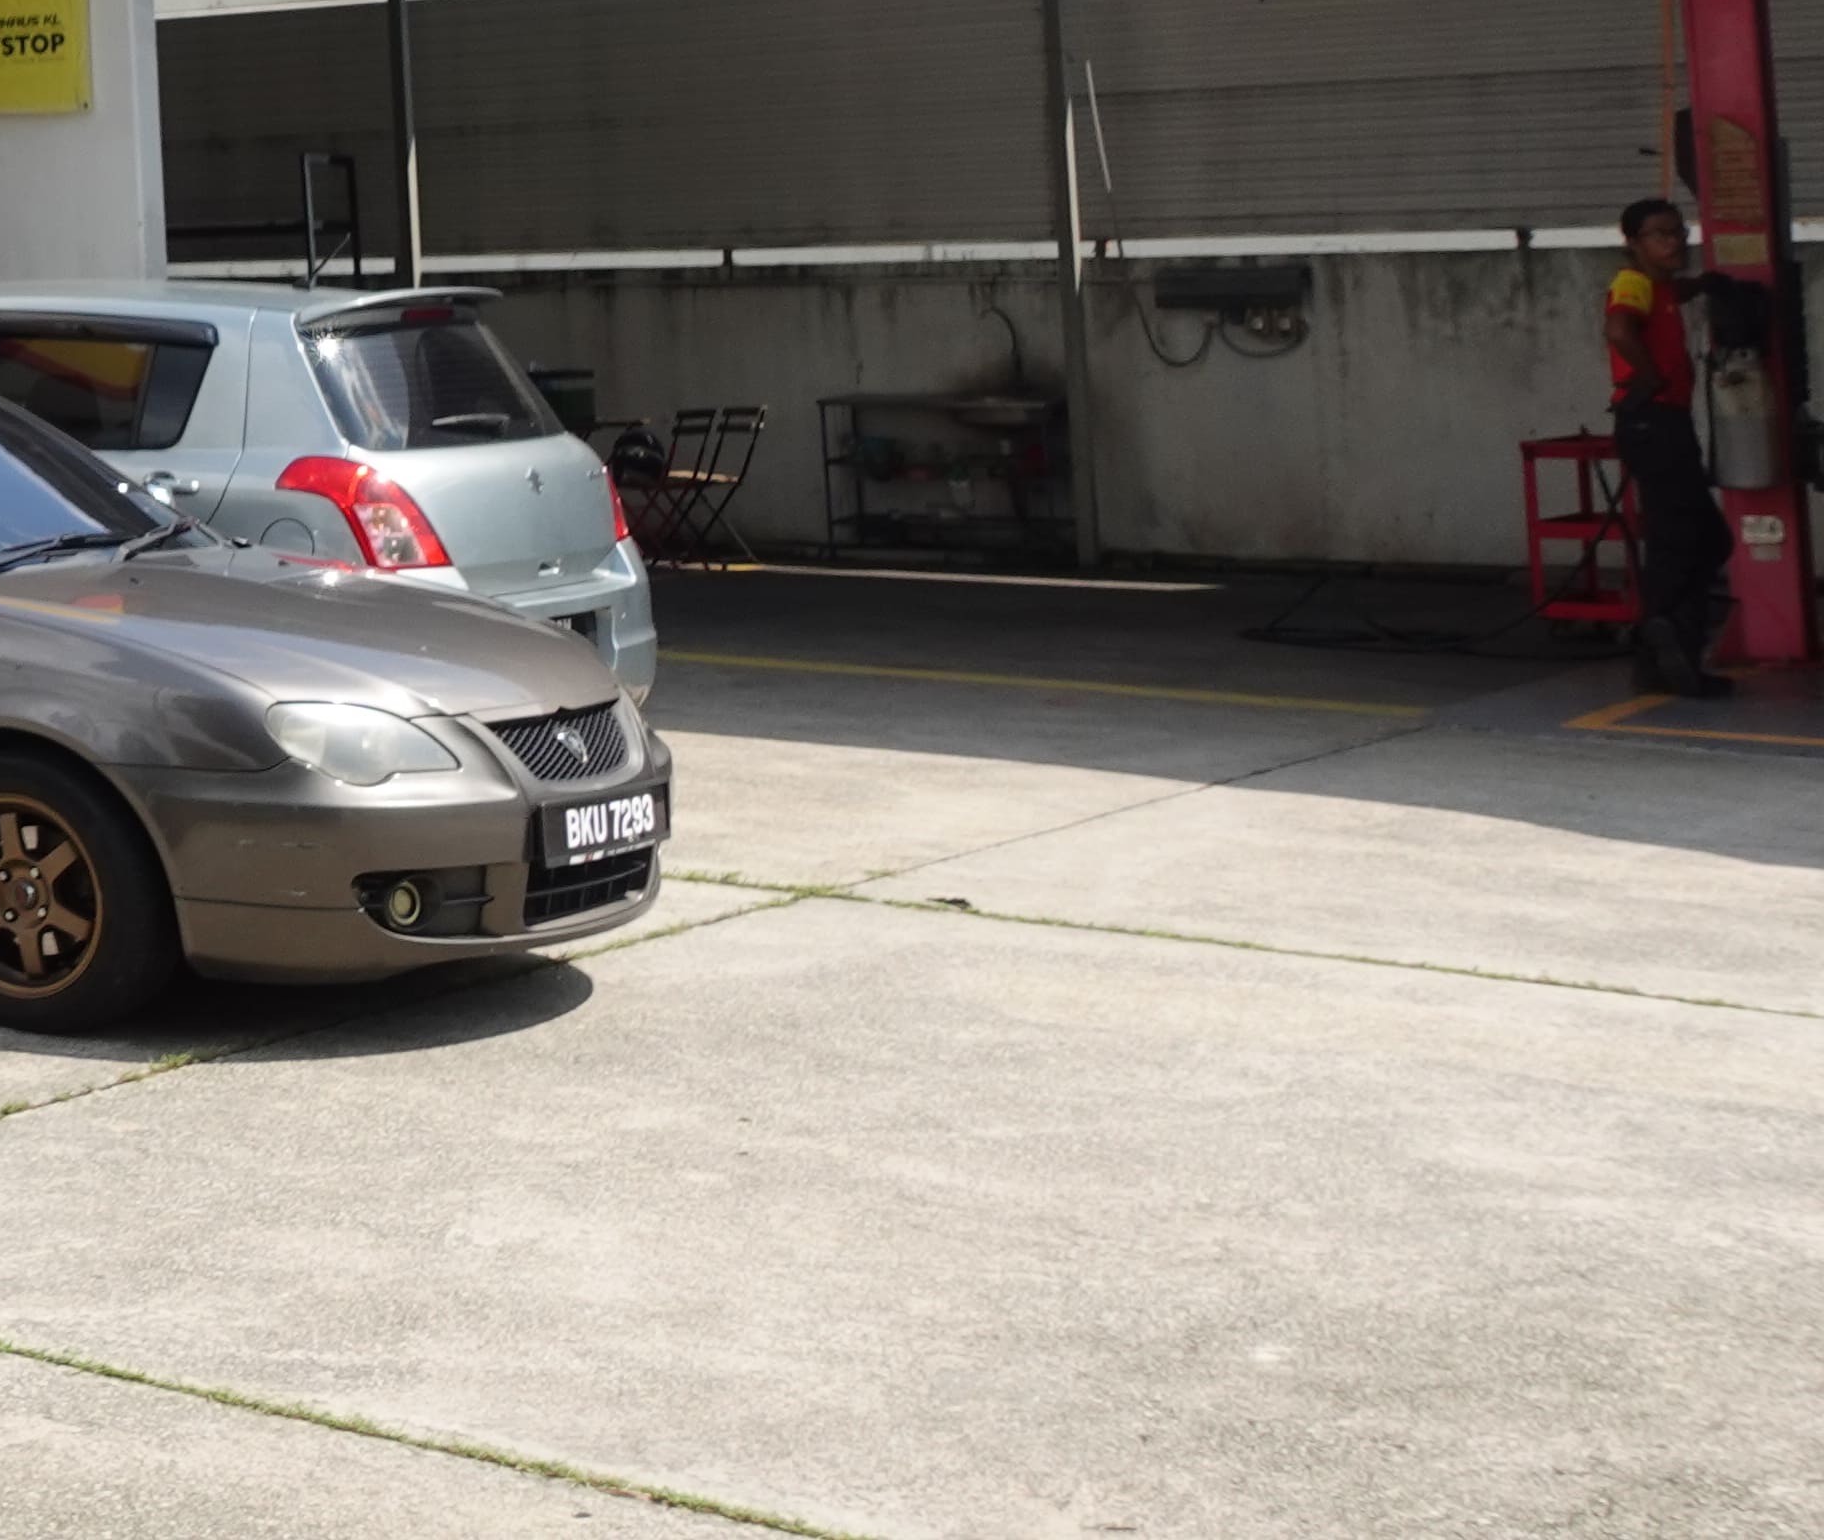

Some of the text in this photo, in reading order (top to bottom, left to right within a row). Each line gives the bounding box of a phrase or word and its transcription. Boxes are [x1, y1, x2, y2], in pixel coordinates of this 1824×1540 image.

[44, 12, 61, 26] KL
[565, 793, 655, 849] BKU 7293
